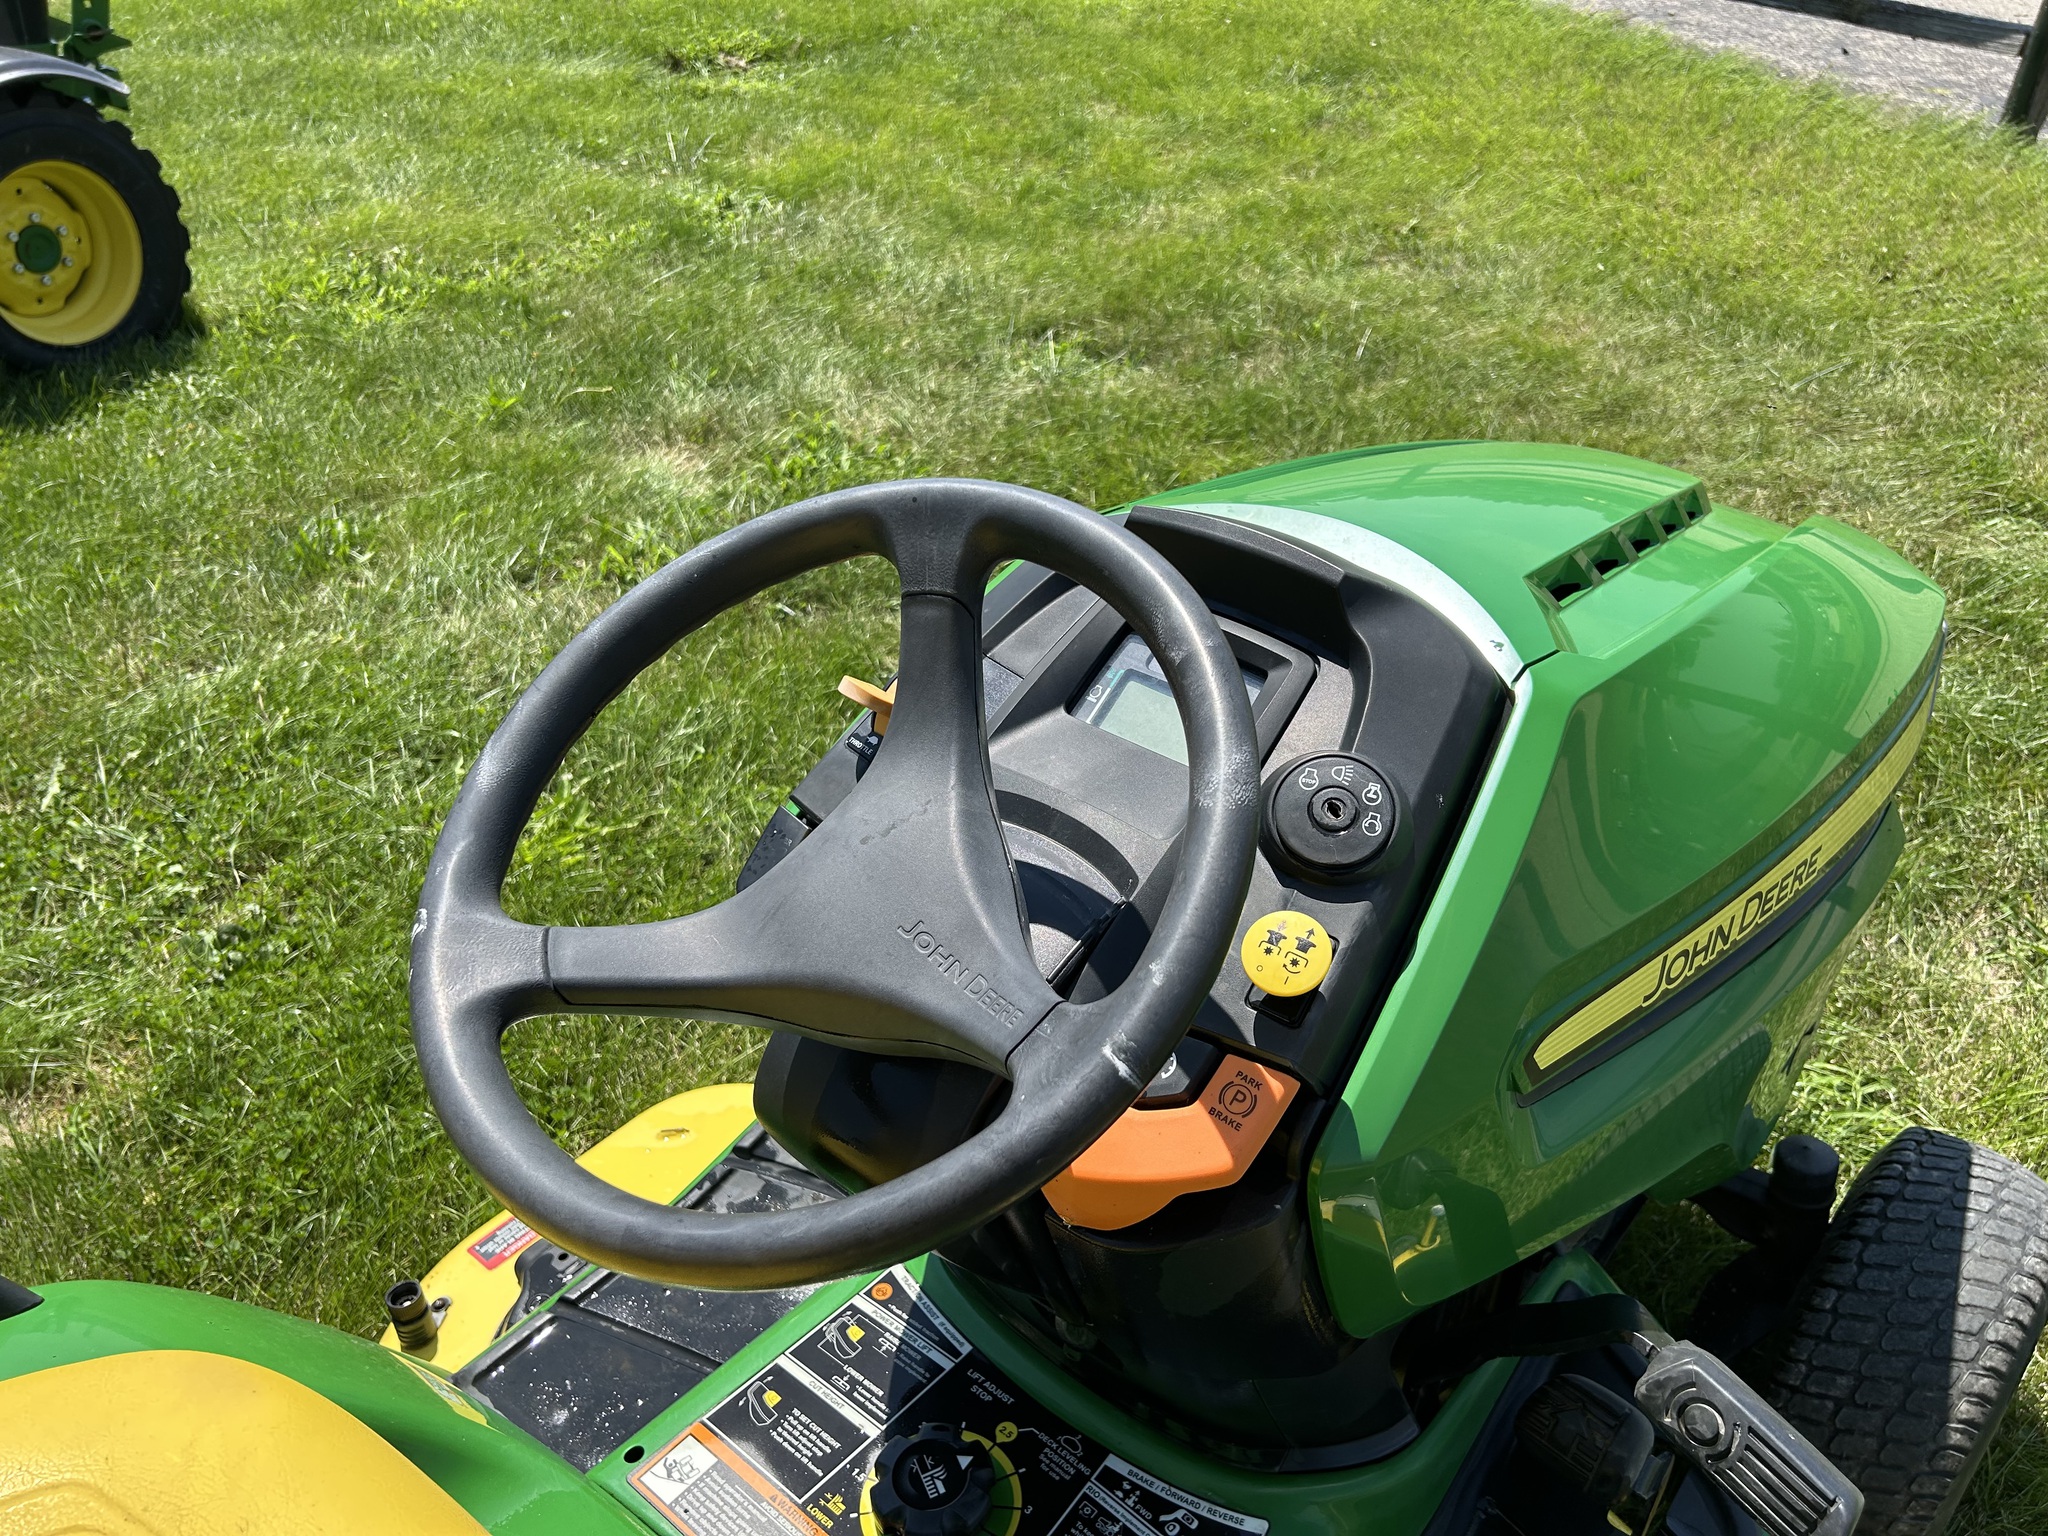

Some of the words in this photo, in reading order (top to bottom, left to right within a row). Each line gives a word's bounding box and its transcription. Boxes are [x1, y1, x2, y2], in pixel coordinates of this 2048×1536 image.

[849, 737, 873, 755] THROTTLE
[1643, 915, 1735, 1005] JOHN
[1737, 845, 1822, 936] DEERE
[897, 920, 969, 984] JOHN
[964, 974, 1024, 1028] DEERE
[1235, 1071, 1263, 1091] PARK
[1229, 1089, 1247, 1106] P
[1208, 1107, 1243, 1132] BRAKE
[890, 1304, 902, 1315] Push
[900, 1275, 924, 1301] TRACTION
[920, 1300, 939, 1320] ASSIST
[871, 1308, 894, 1327] POWER
[893, 1324, 917, 1344] MOWER
[917, 1341, 932, 1354] LIFT
[900, 1343, 921, 1360] MOWER
[843, 1364, 864, 1381] LOWER
[862, 1378, 884, 1396] MOWER
[910, 1361, 925, 1373] handle
[808, 1380, 822, 1392] CUT
[820, 1389, 844, 1409] HEIGHT
[858, 1386, 872, 1398] Lower
[870, 1396, 886, 1409] handle
[966, 1368, 984, 1384] LIFT
[982, 1379, 1014, 1405] ADJUST
[969, 1384, 993, 1403] STOP
[852, 1391, 865, 1402] lower
[863, 1400, 887, 1419] implement
[782, 1421, 793, 1431] Turn
[797, 1434, 813, 1448] adjust
[811, 1445, 823, 1457] stop
[787, 1415, 798, 1425] Pull
[795, 1423, 803, 1431] up
[808, 1433, 816, 1441] lift
[814, 1438, 832, 1453] handle
[792, 1408, 801, 1416] TO
[798, 1413, 811, 1424] SET
[808, 1421, 821, 1433] CUT
[819, 1430, 841, 1449] HEIGHT
[999, 1426, 1014, 1439] 2.5
[770, 1431, 784, 1443] Push
[782, 1440, 796, 1453] down
[800, 1455, 808, 1464] lift
[806, 1461, 824, 1477] handle
[796, 1443, 812, 1457] height
[1037, 1432, 1058, 1449] DECK
[1056, 1446, 1092, 1475] LEVELING
[1042, 1447, 1076, 1474] POSITION
[852, 1468, 867, 1481] 1.5
[1038, 1453, 1050, 1464] See
[1048, 1462, 1071, 1480] manual
[1039, 1463, 1049, 1472] for
[1048, 1470, 1060, 1480] use
[691, 1487, 706, 1501] Keep
[703, 1498, 721, 1515] safety
[719, 1512, 740, 1531] devices
[702, 1486, 724, 1506] machine
[721, 1504, 738, 1519] stops
[735, 1517, 751, 1532] going
[704, 1476, 720, 1491] Avoid
[718, 1488, 738, 1507] sudden
[736, 1505, 750, 1519] turns
[711, 1471, 725, 1484] Read
[747, 1504, 767, 1522] manual
[760, 1500, 778, 1517] AVOID
[1024, 1505, 1033, 1514] 3
[1086, 1485, 1100, 1498] RIO
[1098, 1495, 1121, 1514] (Reverse
[1119, 1512, 1146, 1534] Implement
[1127, 1469, 1155, 1487] BRAKE
[1160, 1485, 1201, 1510] FORWARD
[1206, 1505, 1245, 1526] REVERSE
[674, 1505, 689, 1519] When
[679, 1498, 701, 1519] Remove
[698, 1516, 719, 1536] objects
[686, 1493, 701, 1507] Drive
[698, 1505, 707, 1514] up
[705, 1511, 717, 1522] and
[715, 1520, 731, 1535] down
[776, 1498, 818, 1536] WARNING
[806, 1503, 833, 1528] LOWER
[1075, 1521, 1084, 1530] To
[1134, 1504, 1152, 1520] FWD
